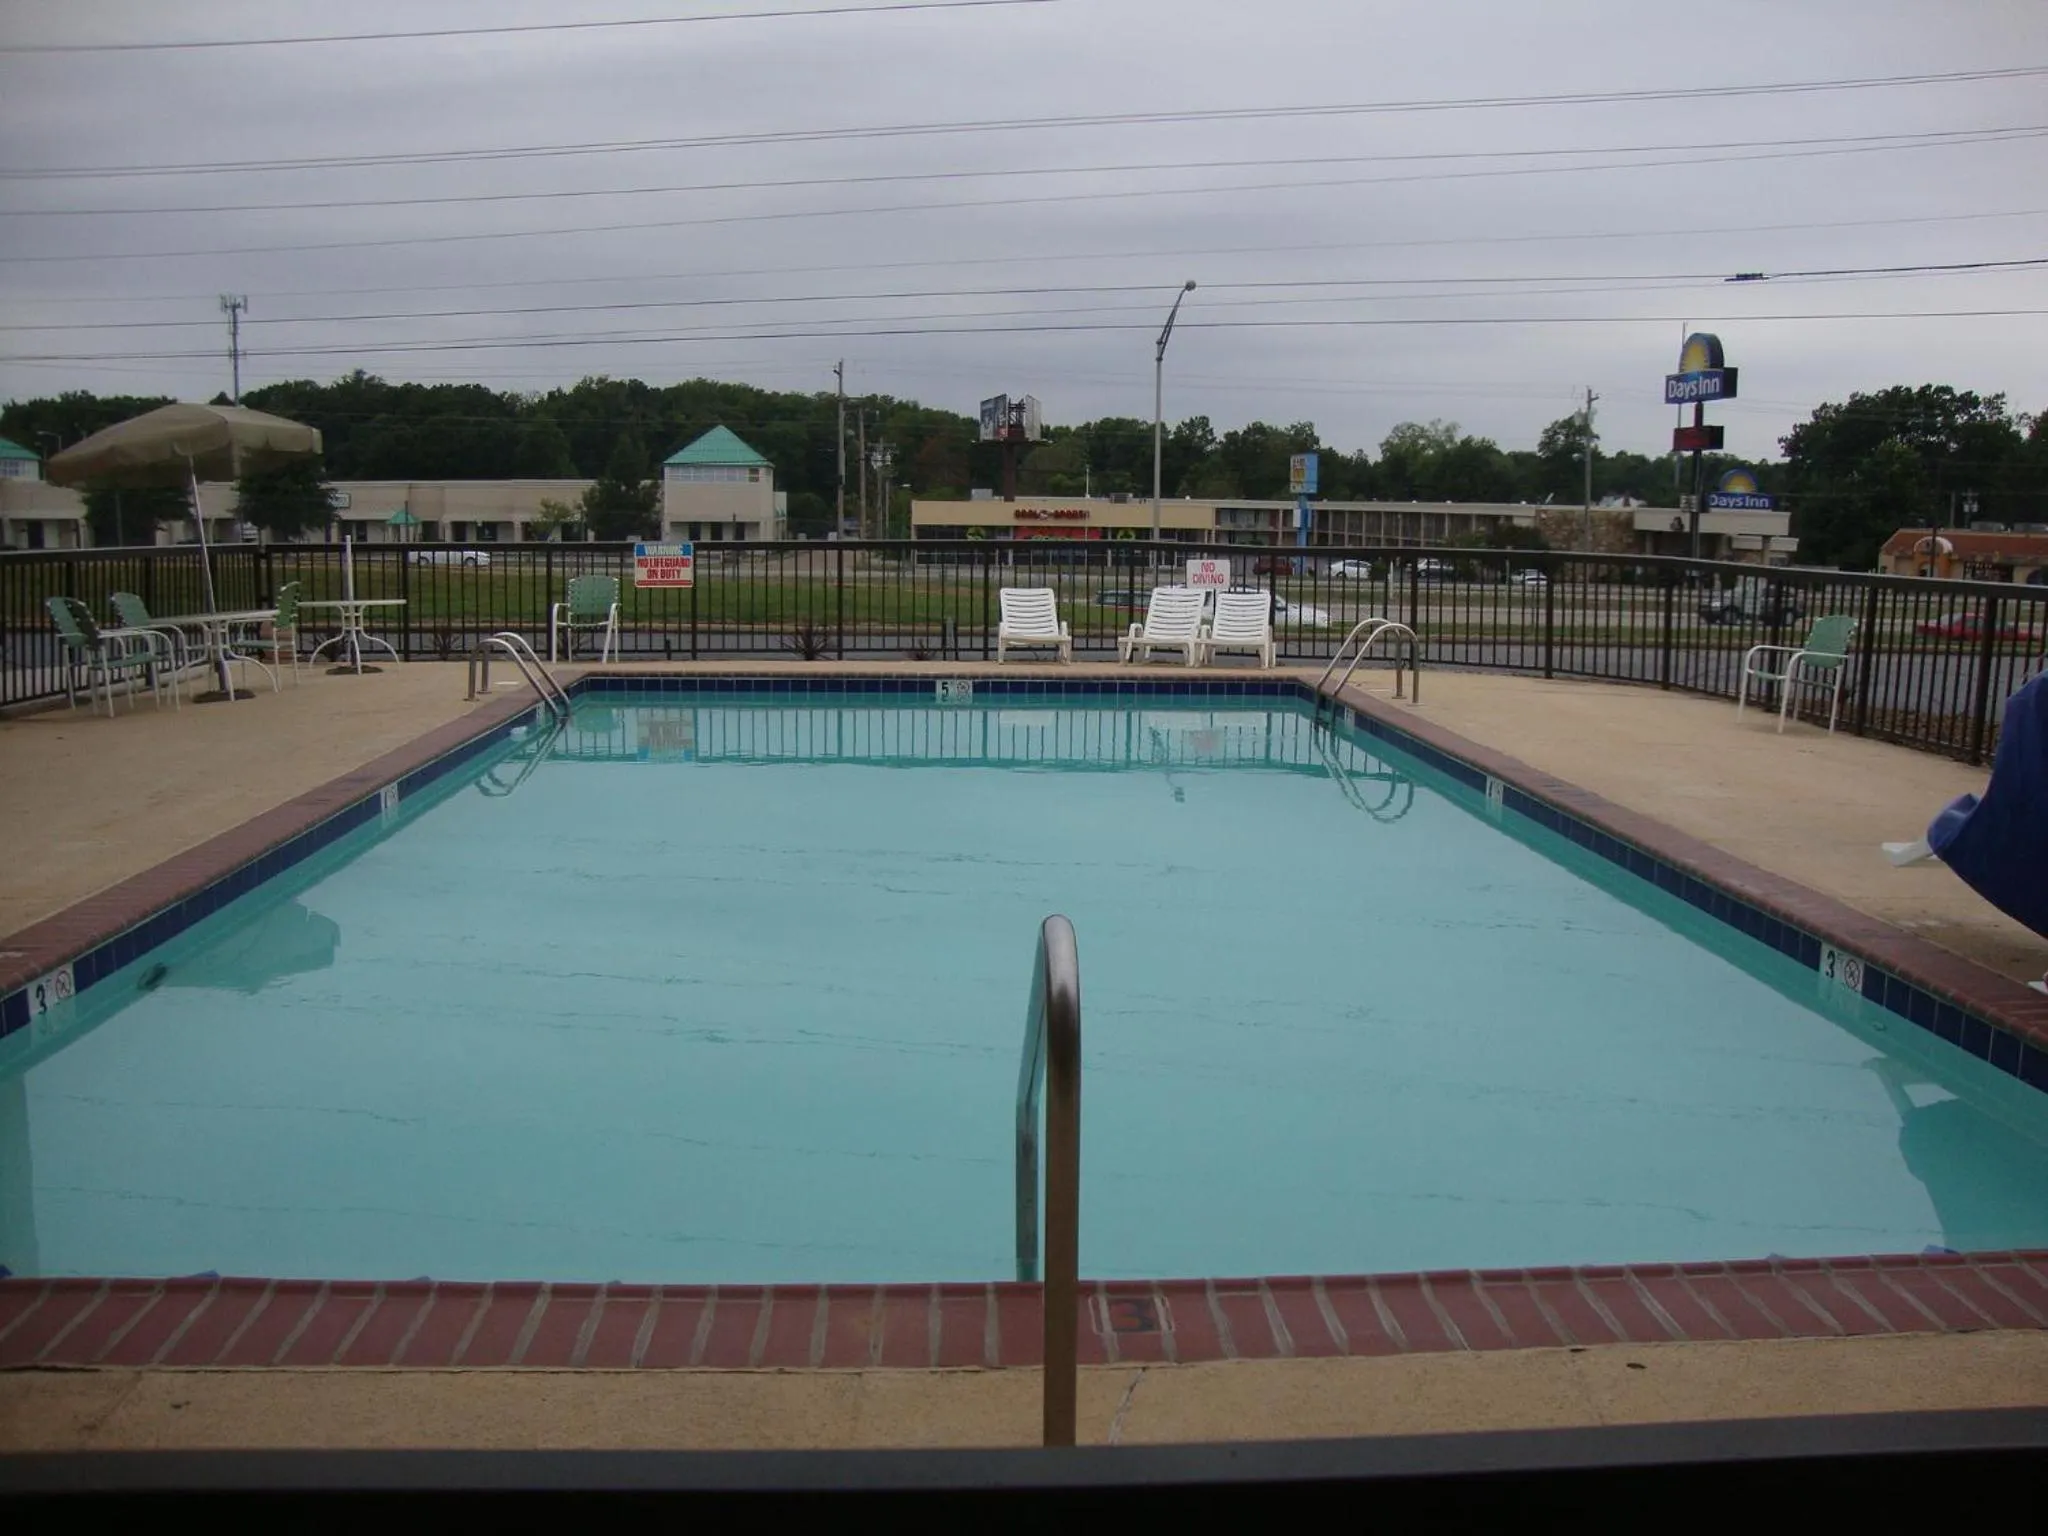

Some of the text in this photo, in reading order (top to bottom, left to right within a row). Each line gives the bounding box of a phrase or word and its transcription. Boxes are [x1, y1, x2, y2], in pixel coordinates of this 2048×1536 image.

[1668, 376, 1720, 399] Days Inn
[1708, 494, 1769, 507] Days Inn
[643, 543, 684, 556] WARNING
[637, 557, 690, 568] NO LIFEGUARD
[1201, 562, 1215, 572] NO
[647, 569, 681, 579] ON DUTY
[1192, 573, 1224, 584] DIVING
[941, 682, 949, 697] 5
